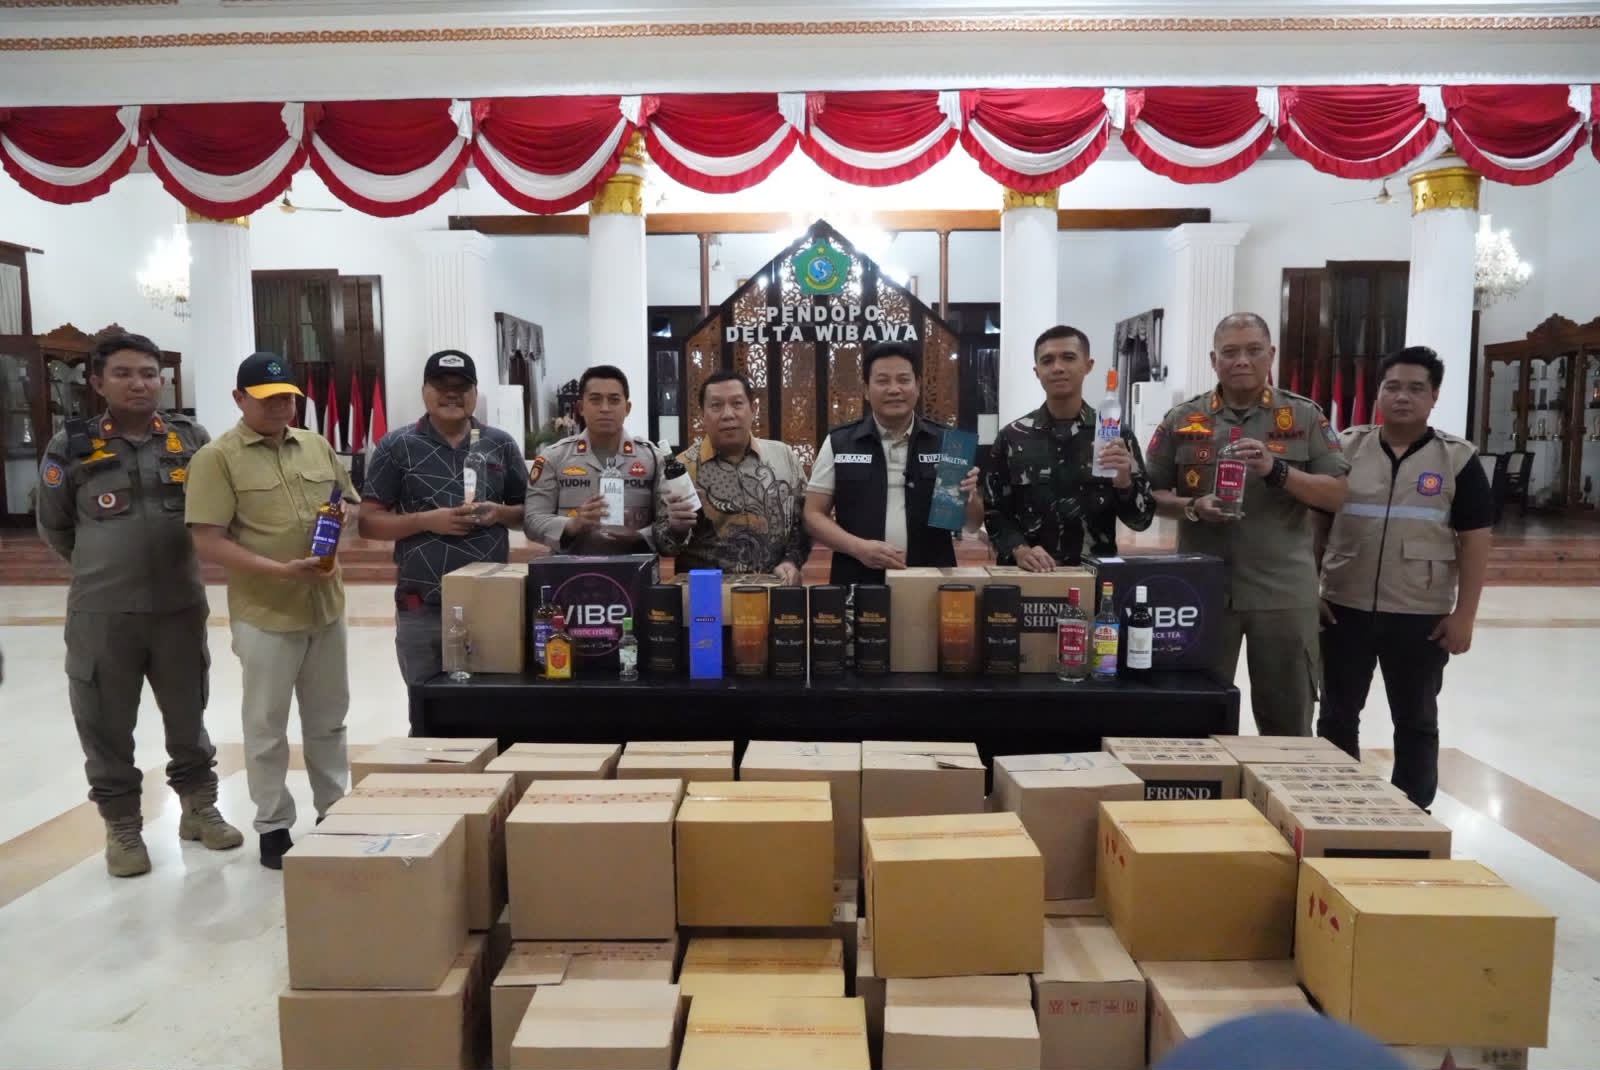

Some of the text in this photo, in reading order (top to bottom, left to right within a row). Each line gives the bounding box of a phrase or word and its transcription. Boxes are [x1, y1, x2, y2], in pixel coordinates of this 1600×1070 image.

[766, 304, 880, 322] PENDOPO
[726, 323, 919, 343] DELTA WIBAWA
[559, 478, 591, 488] YUDHI
[1021, 602, 1064, 615] RIEN
[1145, 786, 1212, 800] FRIEND
